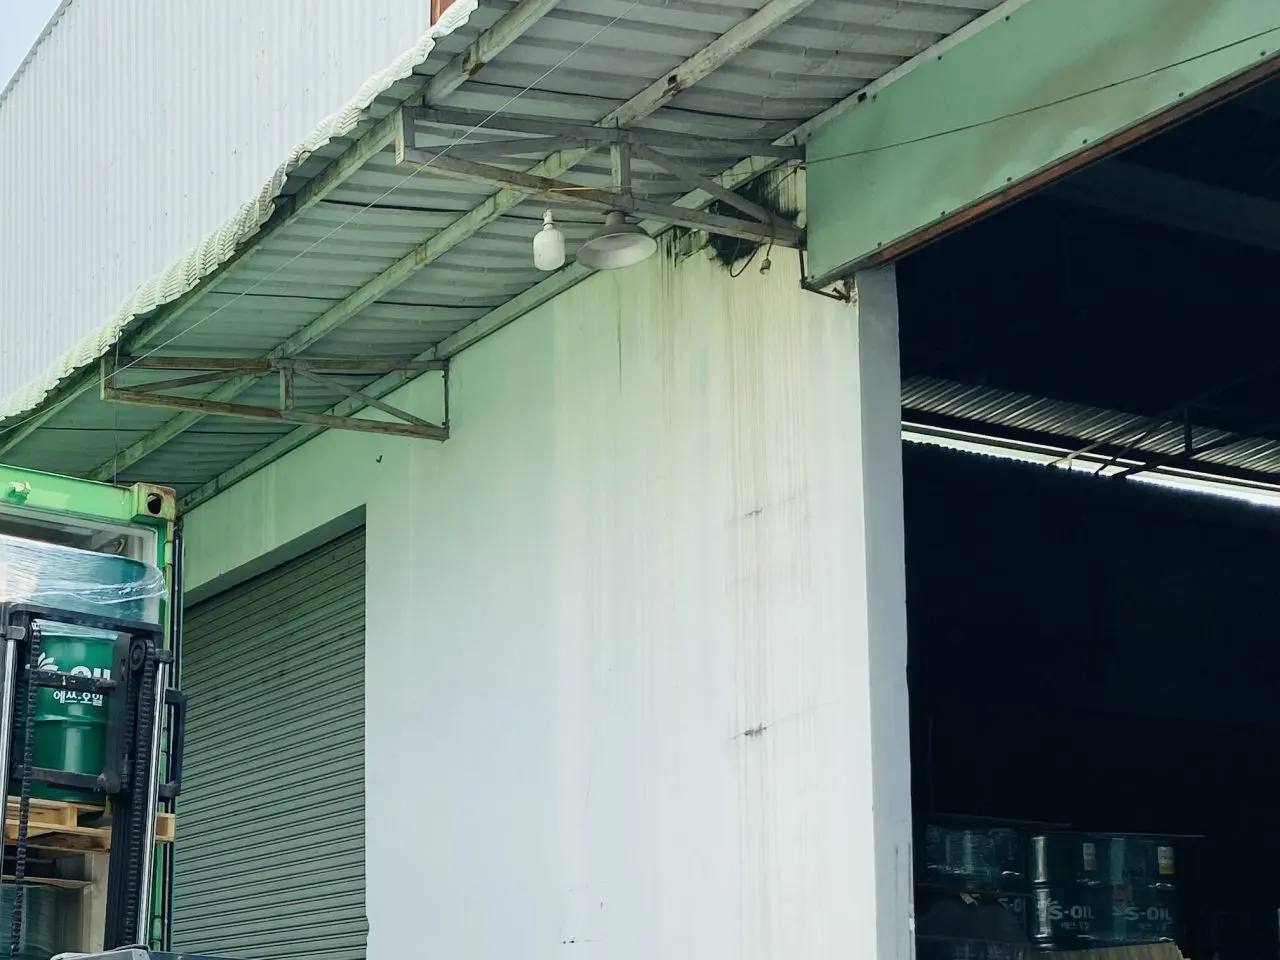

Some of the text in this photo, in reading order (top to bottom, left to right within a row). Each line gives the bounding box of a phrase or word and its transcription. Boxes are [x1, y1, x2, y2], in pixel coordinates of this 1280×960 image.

[53, 690, 104, 707] 에쓰-오일
[1049, 904, 1097, 920] S-OIL
[1125, 906, 1174, 921] S-OIL
